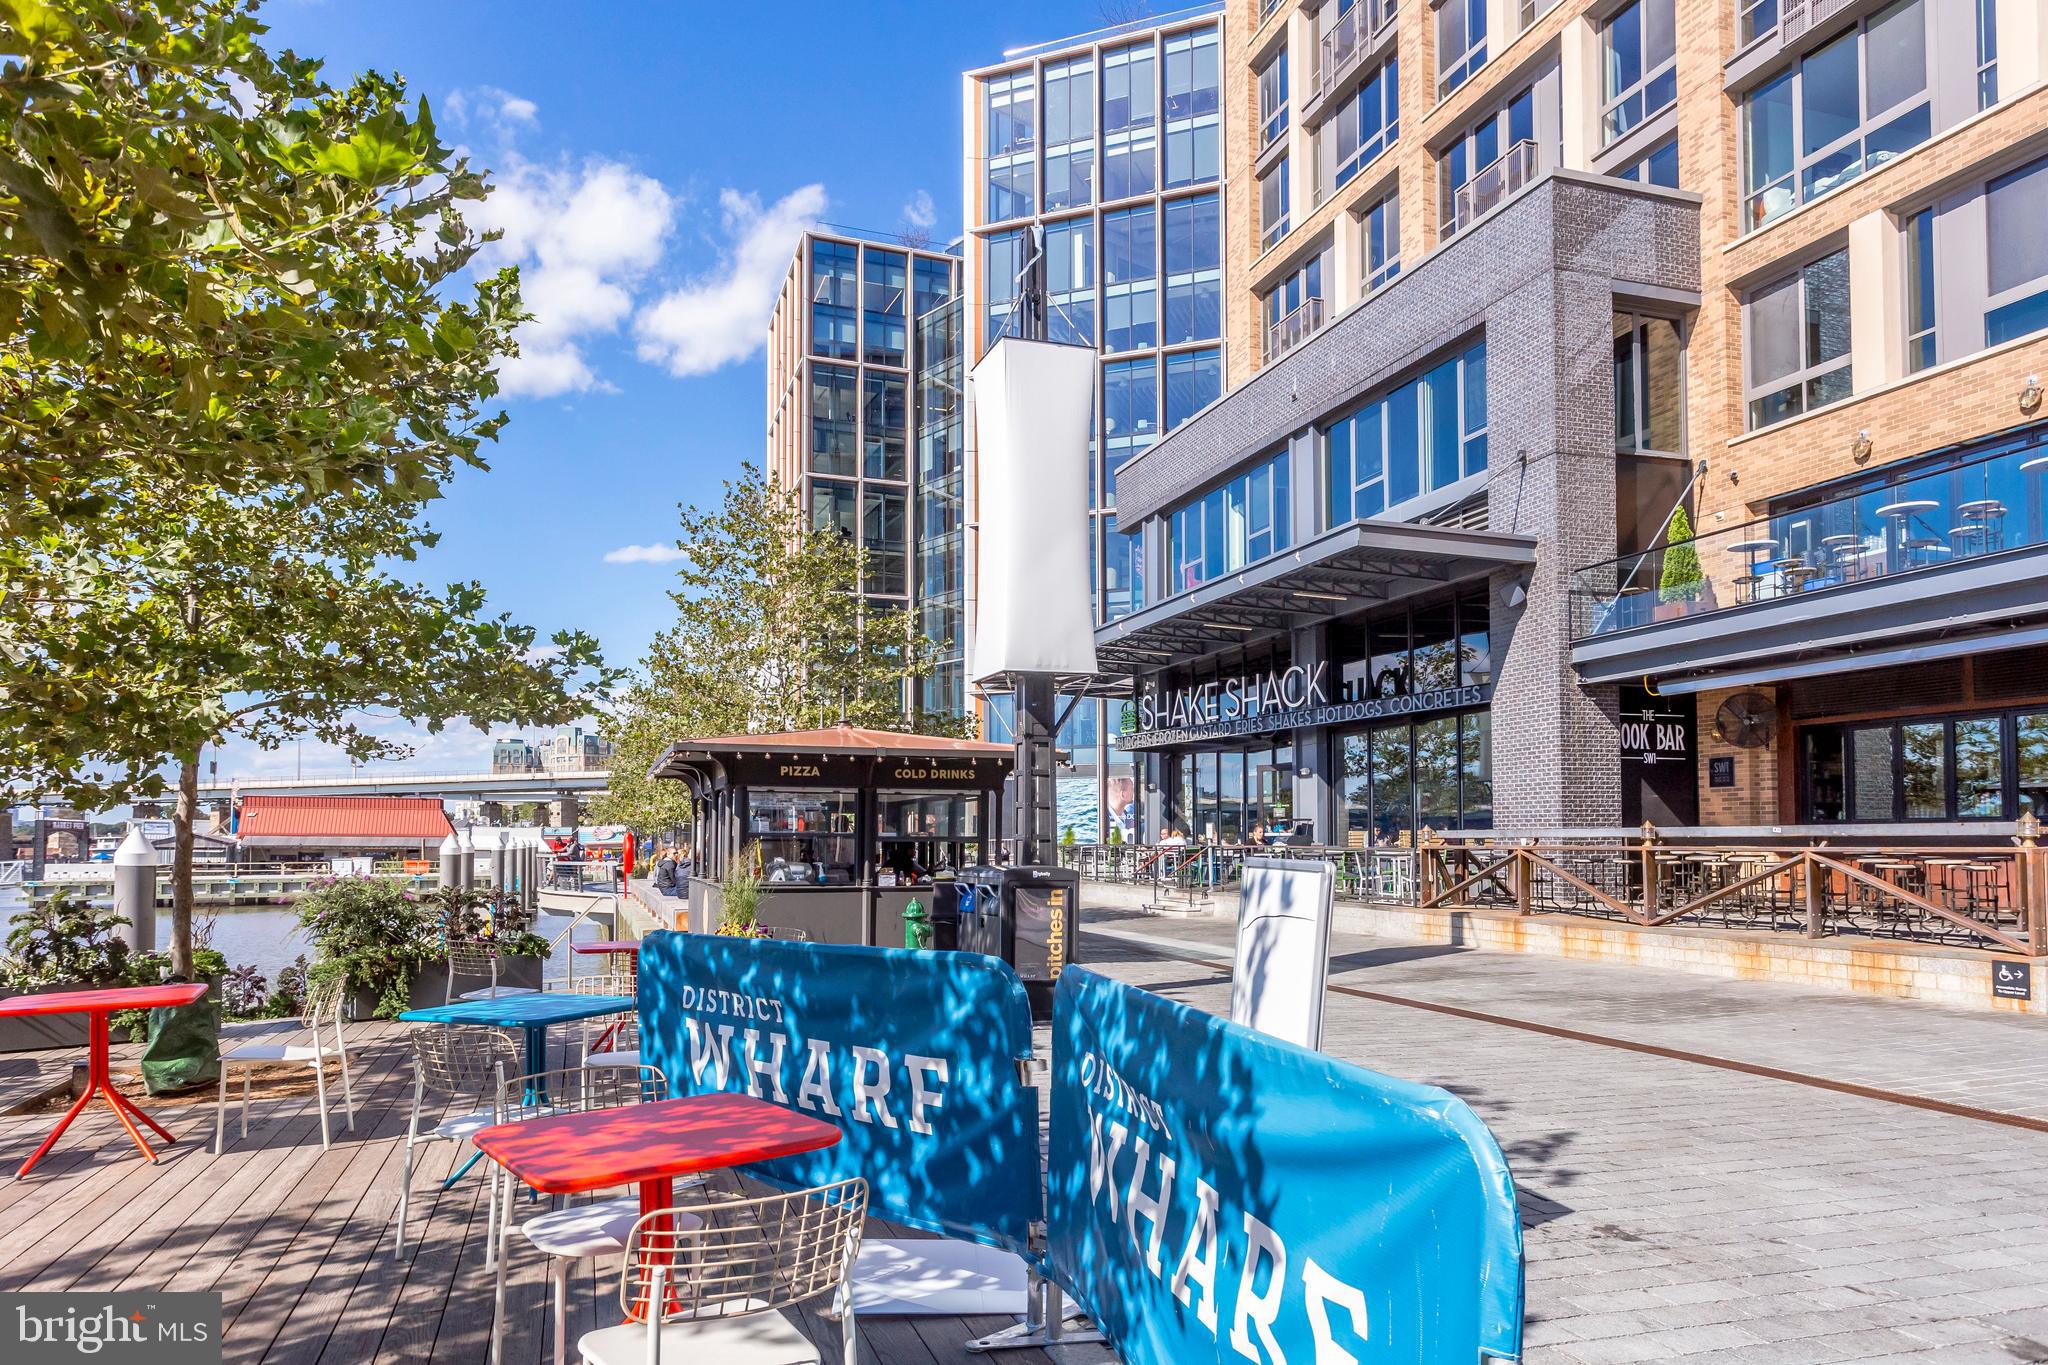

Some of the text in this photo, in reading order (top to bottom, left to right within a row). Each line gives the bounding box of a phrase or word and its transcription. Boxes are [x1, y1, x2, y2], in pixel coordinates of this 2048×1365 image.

[1142, 681, 1219, 730] SHAKE
[1225, 661, 1328, 717] SHACK
[1155, 730, 1188, 746] FROZEN
[1189, 722, 1231, 740] CUSTARD
[1235, 718, 1263, 733] FRIES
[1268, 710, 1312, 729] SHAKES
[1317, 708, 1342, 723] HOT
[1345, 700, 1382, 720] DOGS
[1390, 685, 1482, 714] CONCRETES
[1642, 709, 1655, 721] THE
[1620, 722, 1685, 751] OOK BAR
[780, 765, 820, 777] PIZZA
[894, 768, 975, 780] COLD DRINKS
[1047, 889, 1063, 979] pitches in
[682, 985, 783, 1023] DISTRICT
[685, 1017, 949, 1135] WHARF
[1088, 1104, 1369, 1365] WHARF
